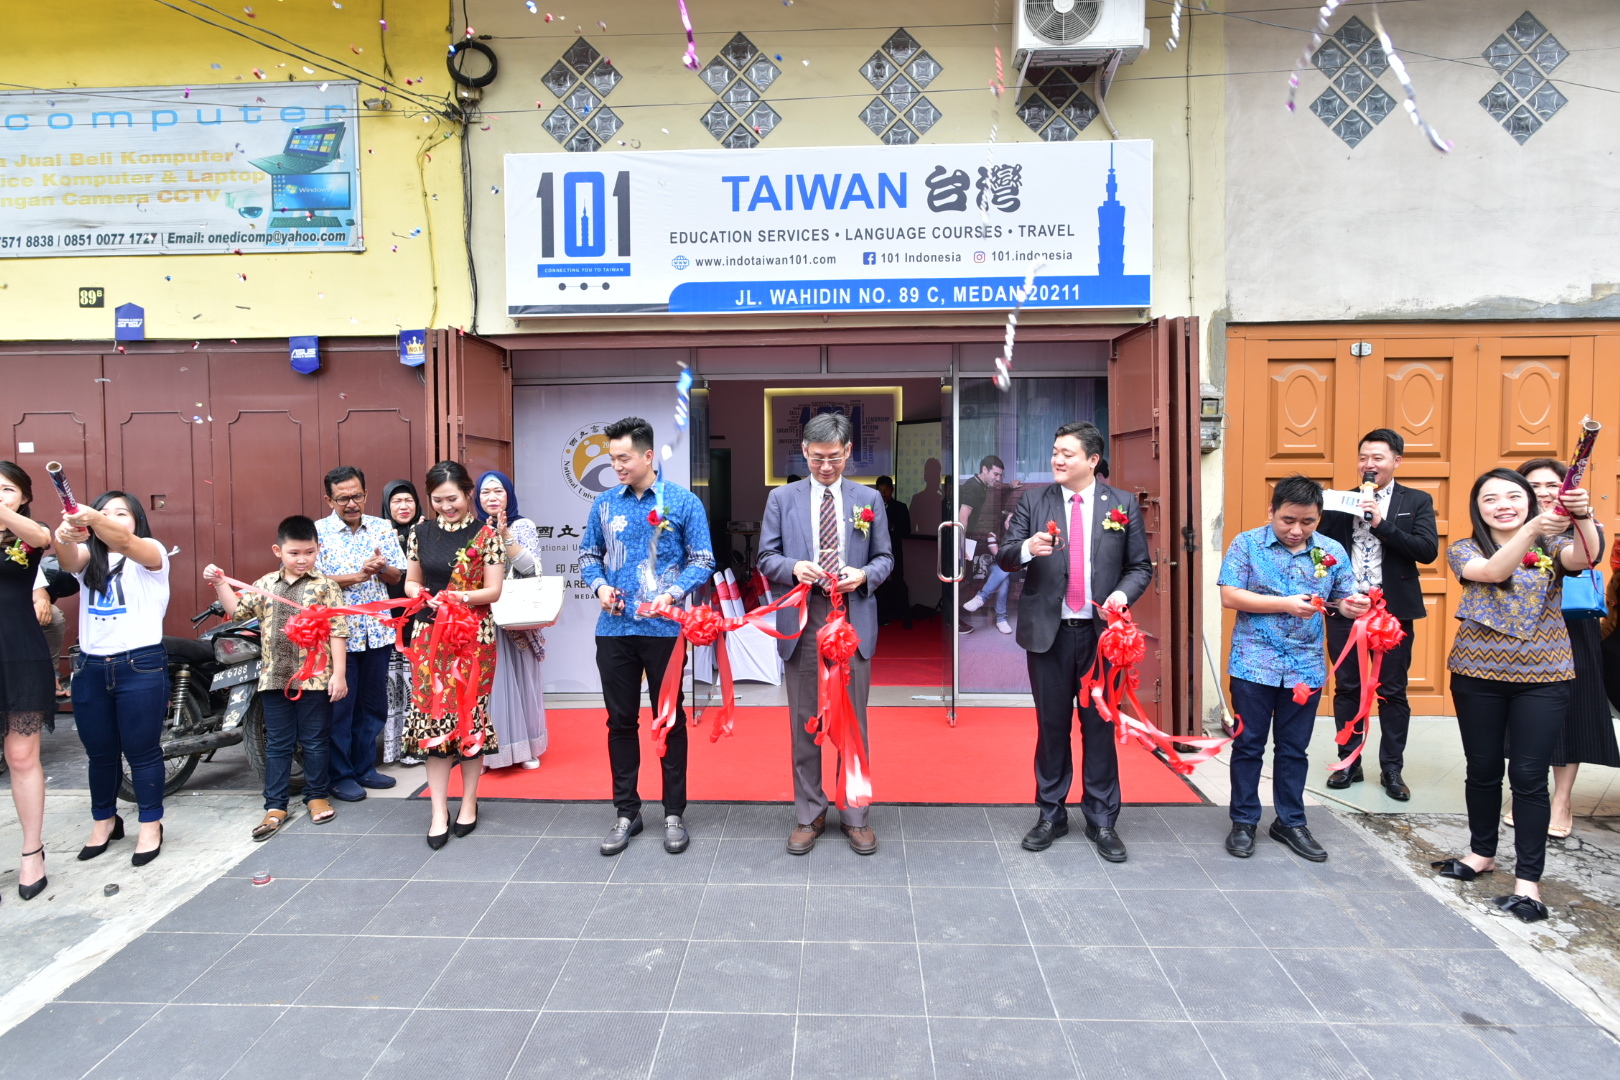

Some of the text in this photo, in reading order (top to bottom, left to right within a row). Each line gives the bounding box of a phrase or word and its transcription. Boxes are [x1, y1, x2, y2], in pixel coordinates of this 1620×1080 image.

[4, 104, 347, 131] computer
[14, 154, 62, 167] Jual
[70, 152, 113, 166] Beli
[121, 150, 234, 166] Komputer
[42, 172, 154, 188] Komputer
[161, 171, 177, 183] &
[187, 169, 266, 184] Laptop
[721, 163, 1023, 213] TAIWAN 台灣
[62, 192, 149, 206] Camera
[157, 189, 221, 203] CCTV
[536, 170, 631, 258] 101
[26, 235, 54, 248] 8838
[64, 234, 92, 247] 0851
[96, 233, 125, 246] 0077
[168, 232, 204, 244] Email:
[208, 230, 346, 246] onedicomp@yahoo.com
[670, 224, 1075, 244] EDUCATION SERVICES LANGUAGE COURSES TRAVEL
[695, 254, 837, 267] www.indotaiwan101.com
[881, 252, 962, 263] 101 Indonesia
[992, 250, 1073, 261] 101.indonesia
[735, 283, 1080, 306] JL. WAHIDIN NO. 89 C, MEDAN 20211
[291, 348, 316, 356] ASUS
[563, 460, 579, 490] National
[213, 670, 225, 682] BK
[227, 664, 248, 678] 6788
